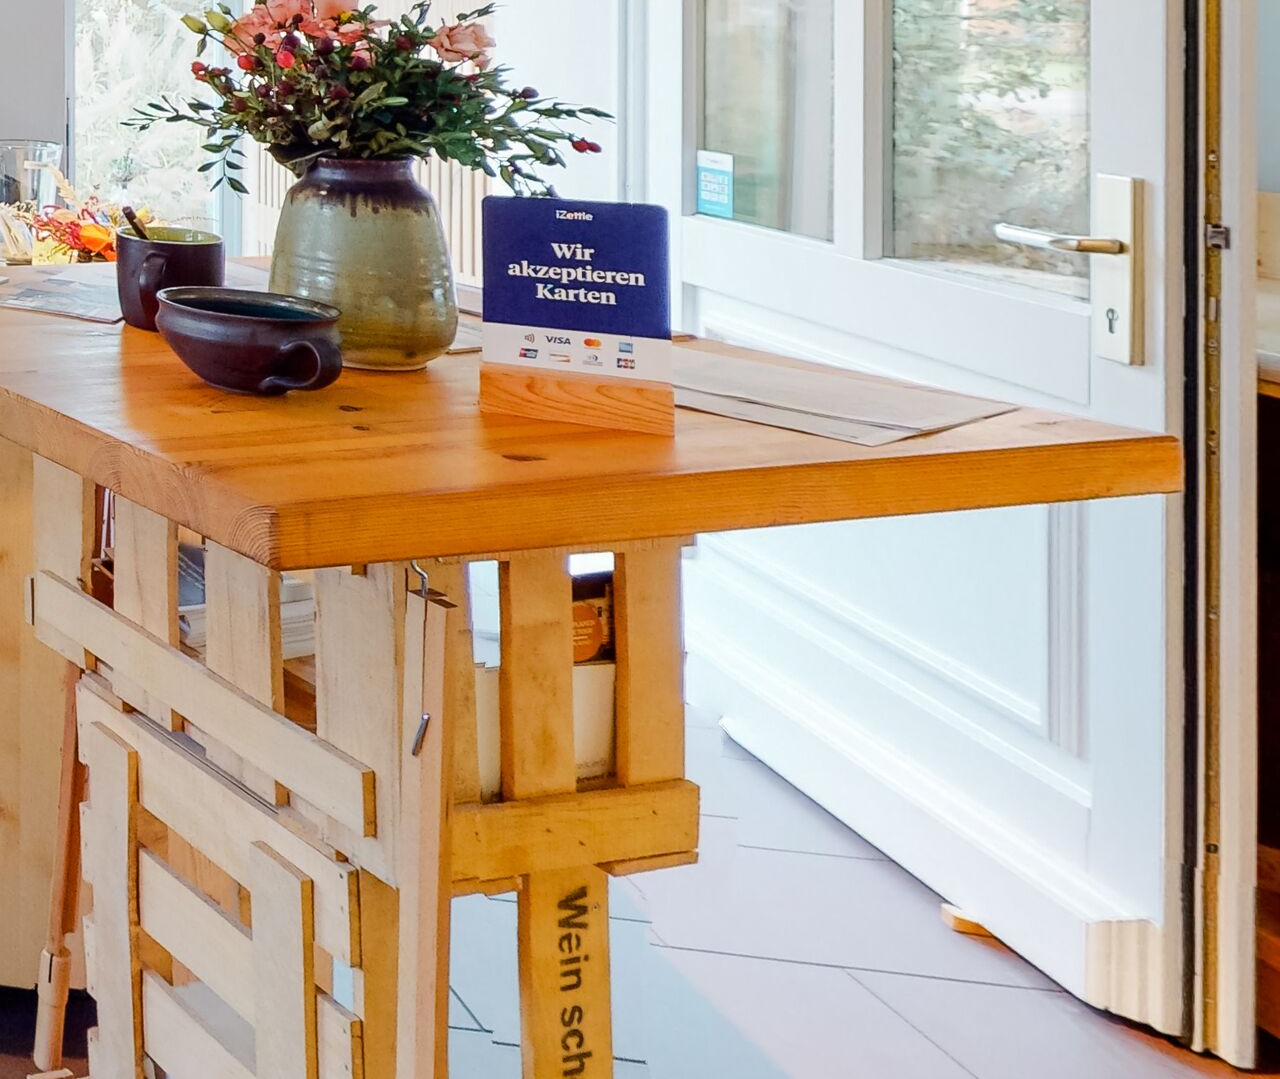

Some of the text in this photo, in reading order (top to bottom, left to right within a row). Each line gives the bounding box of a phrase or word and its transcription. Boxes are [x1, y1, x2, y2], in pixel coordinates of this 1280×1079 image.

[555, 209, 594, 221] iZettle
[550, 242, 596, 261] Wir
[507, 260, 646, 287] akzeptieren
[535, 283, 618, 306] Karten
[545, 335, 571, 345] VISA
[557, 885, 593, 1079] Wein sch
